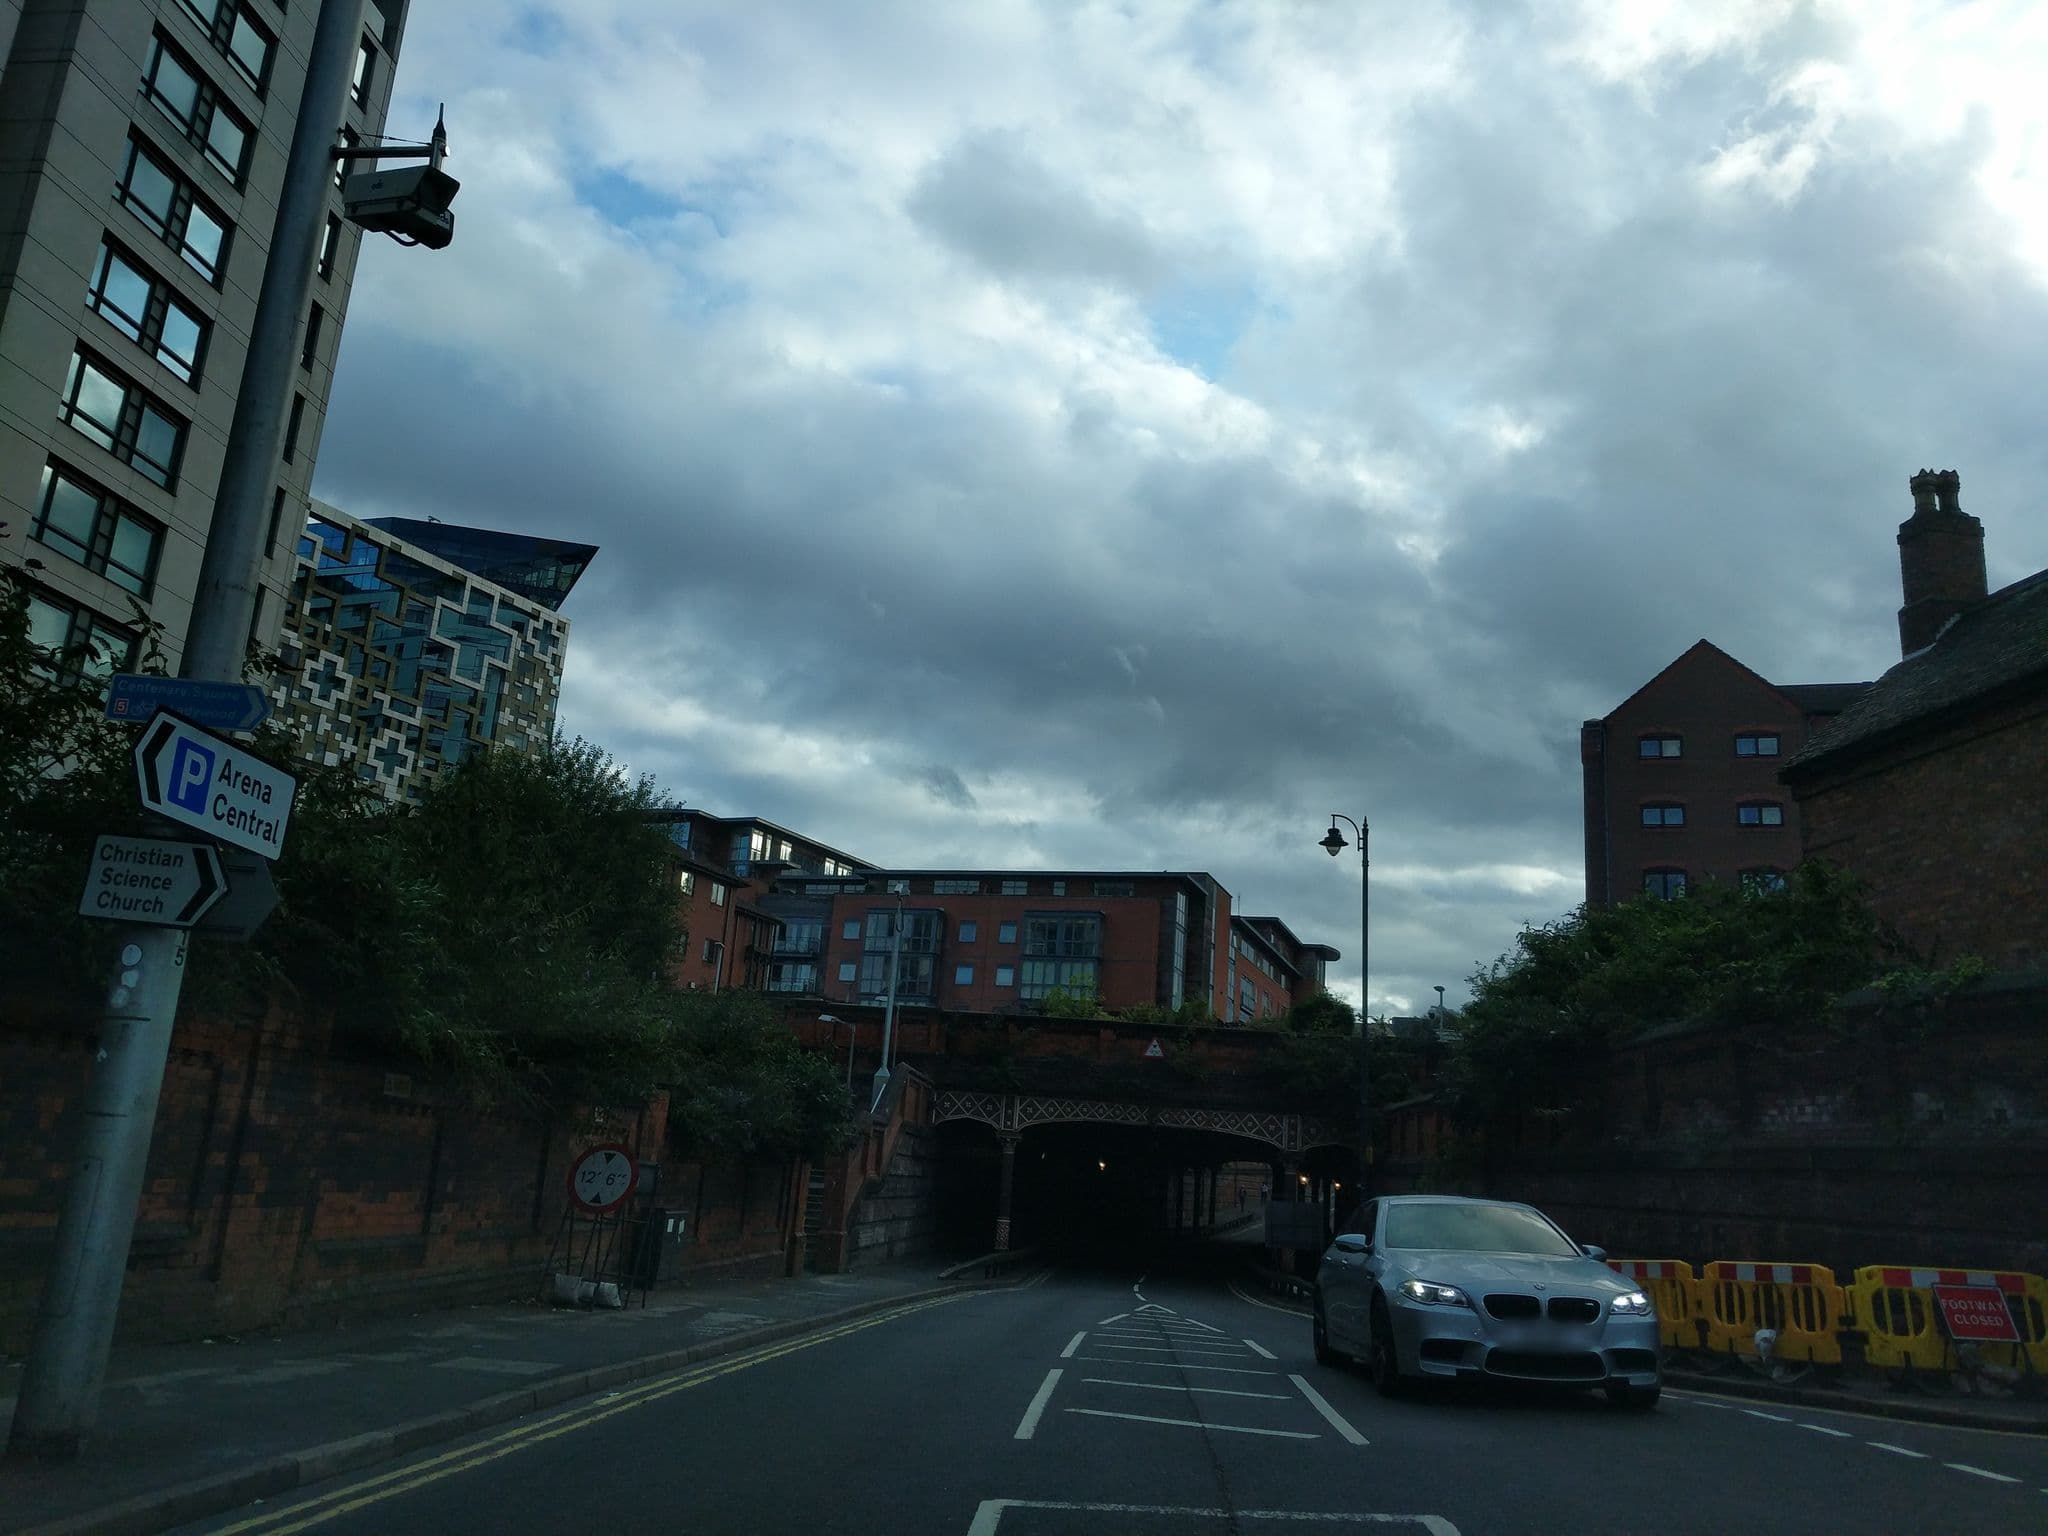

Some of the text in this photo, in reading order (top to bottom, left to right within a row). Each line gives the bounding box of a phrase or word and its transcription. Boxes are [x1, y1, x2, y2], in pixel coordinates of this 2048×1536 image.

[178, 748, 208, 800] P
[218, 758, 273, 805] Arena
[213, 794, 281, 845] Central
[100, 844, 184, 867] Christian
[100, 868, 173, 891] Science
[97, 891, 164, 914] Church
[1941, 1299, 2004, 1312] FOOTWAY
[1954, 1313, 2003, 1327] CLOSED
